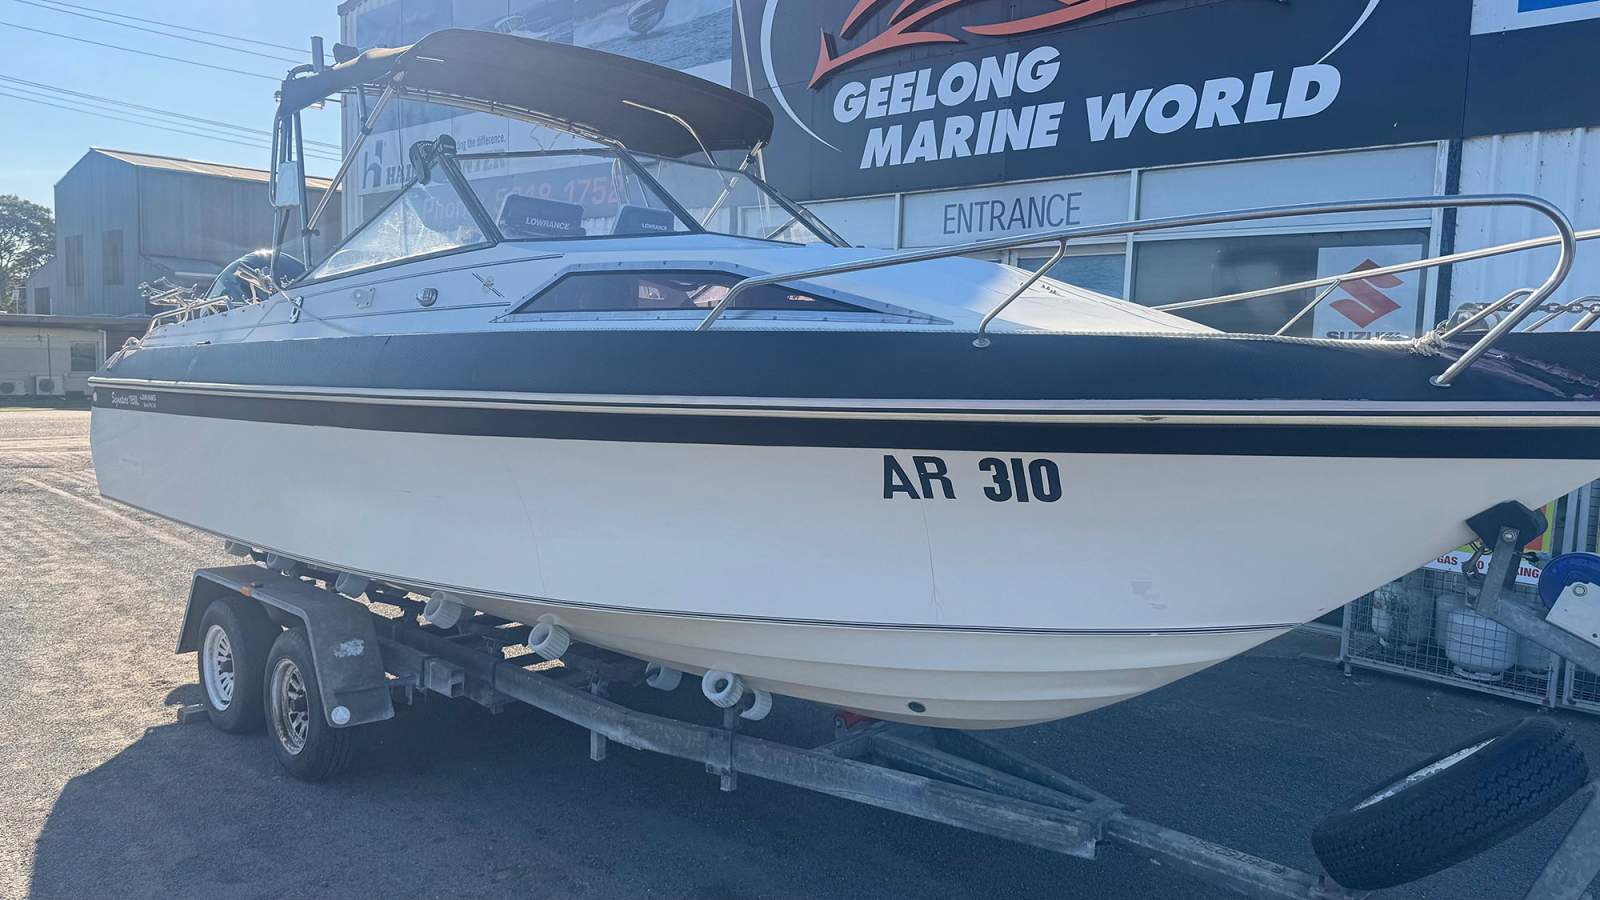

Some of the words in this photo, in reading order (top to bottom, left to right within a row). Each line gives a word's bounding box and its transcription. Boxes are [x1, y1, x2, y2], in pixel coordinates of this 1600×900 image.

[833, 45, 1061, 124] GEELONG
[859, 101, 1065, 170] MARINE
[1086, 63, 1342, 142] WORLD
[525, 216, 570, 231] LOWRANCE
[943, 192, 1083, 235] ENTRANCE
[883, 454, 957, 500] AR
[978, 457, 1063, 503] 310
[1436, 555, 1458, 566] GAS
